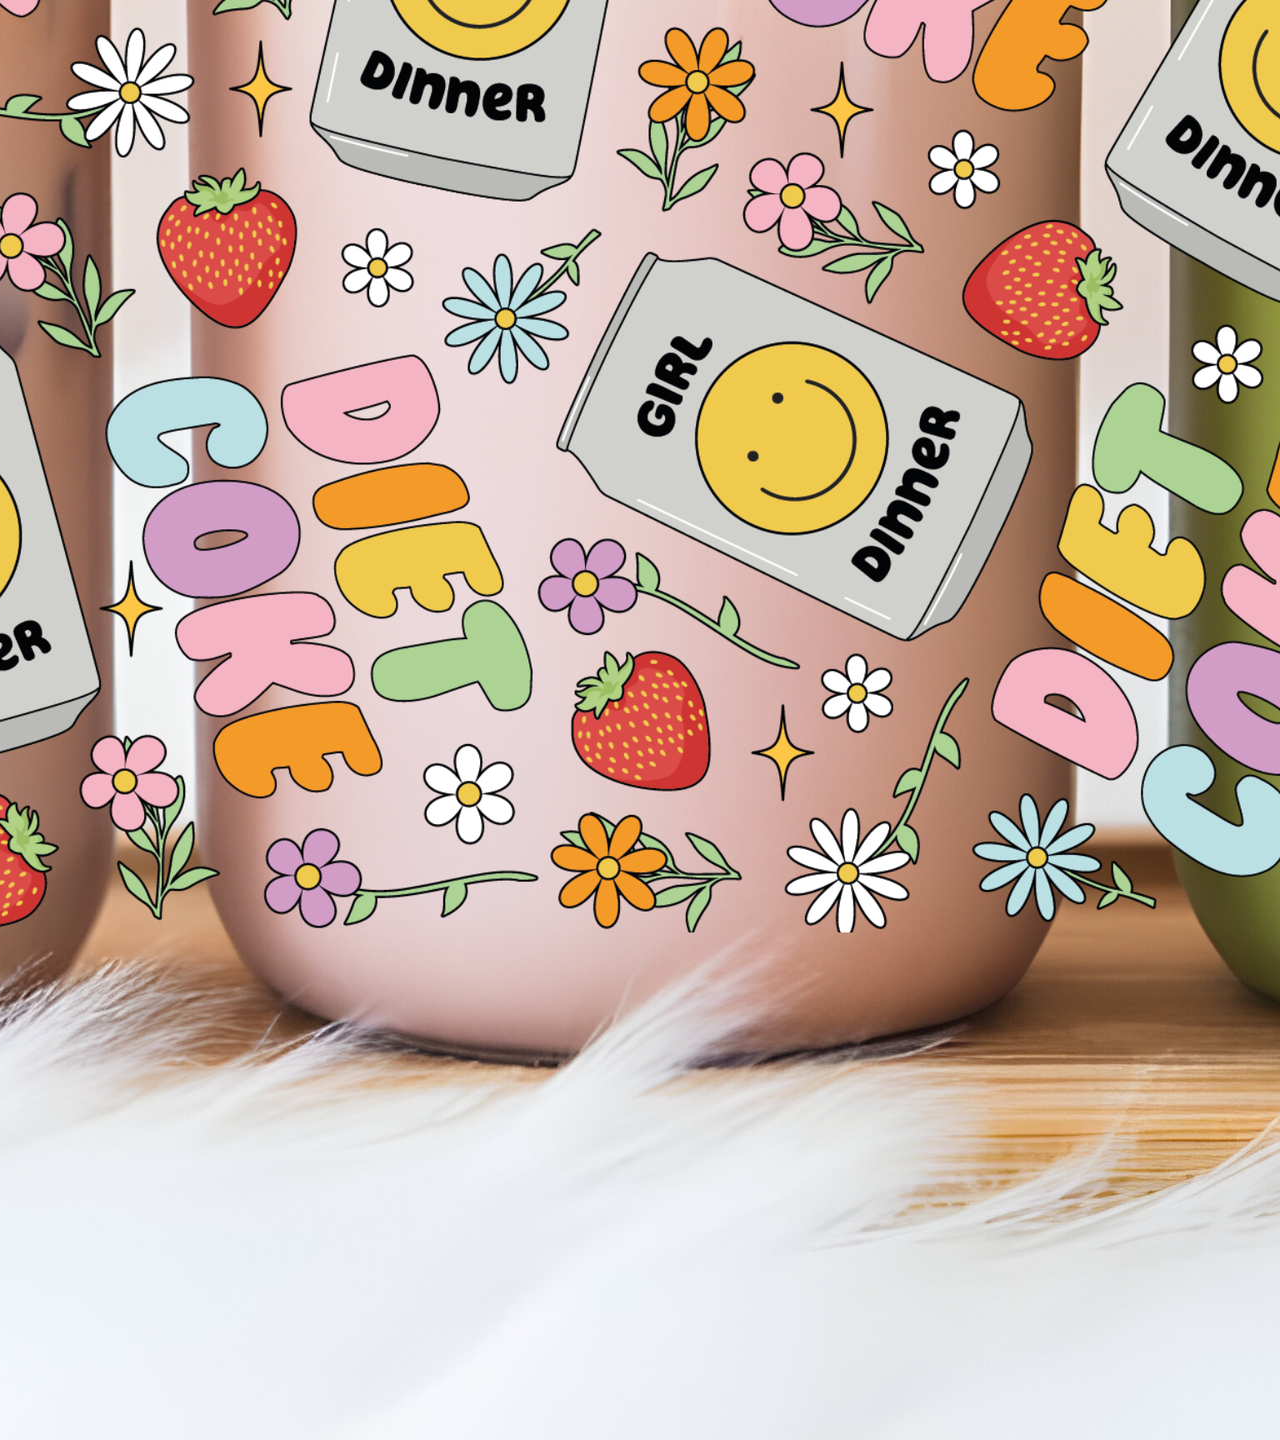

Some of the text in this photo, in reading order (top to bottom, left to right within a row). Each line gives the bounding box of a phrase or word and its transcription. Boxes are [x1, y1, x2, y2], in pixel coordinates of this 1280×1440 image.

[280, 354, 533, 712] DIET
[638, 336, 712, 437] GIRL
[105, 376, 383, 799] COKE
[990, 382, 1244, 780] DIET
